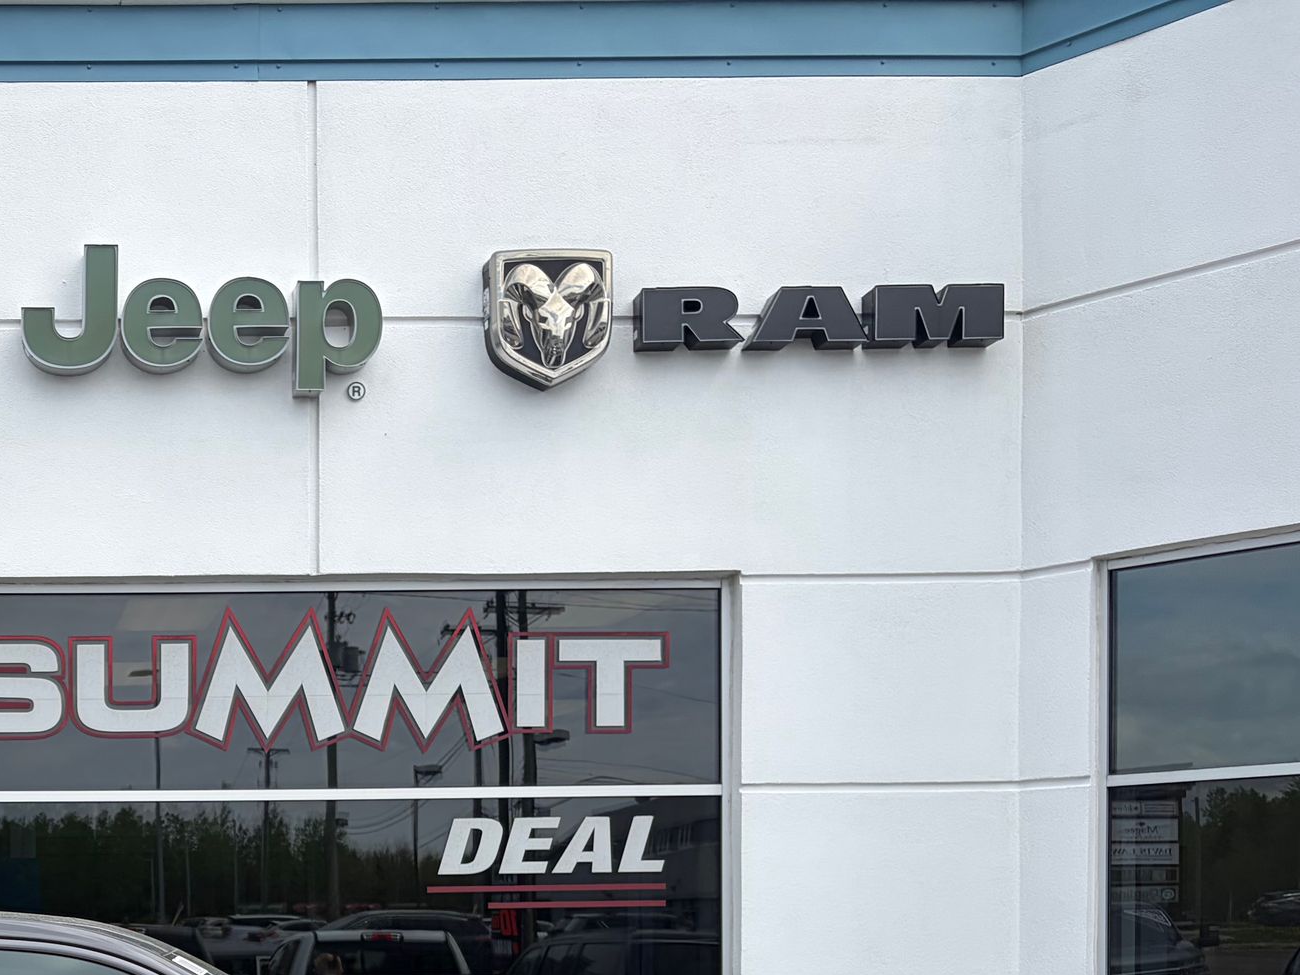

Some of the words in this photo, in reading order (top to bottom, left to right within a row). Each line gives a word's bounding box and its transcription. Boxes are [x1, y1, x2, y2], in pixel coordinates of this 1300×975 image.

[20, 244, 384, 399] Jeep
[633, 283, 1005, 352] RAM
[437, 814, 667, 877] DEAL
